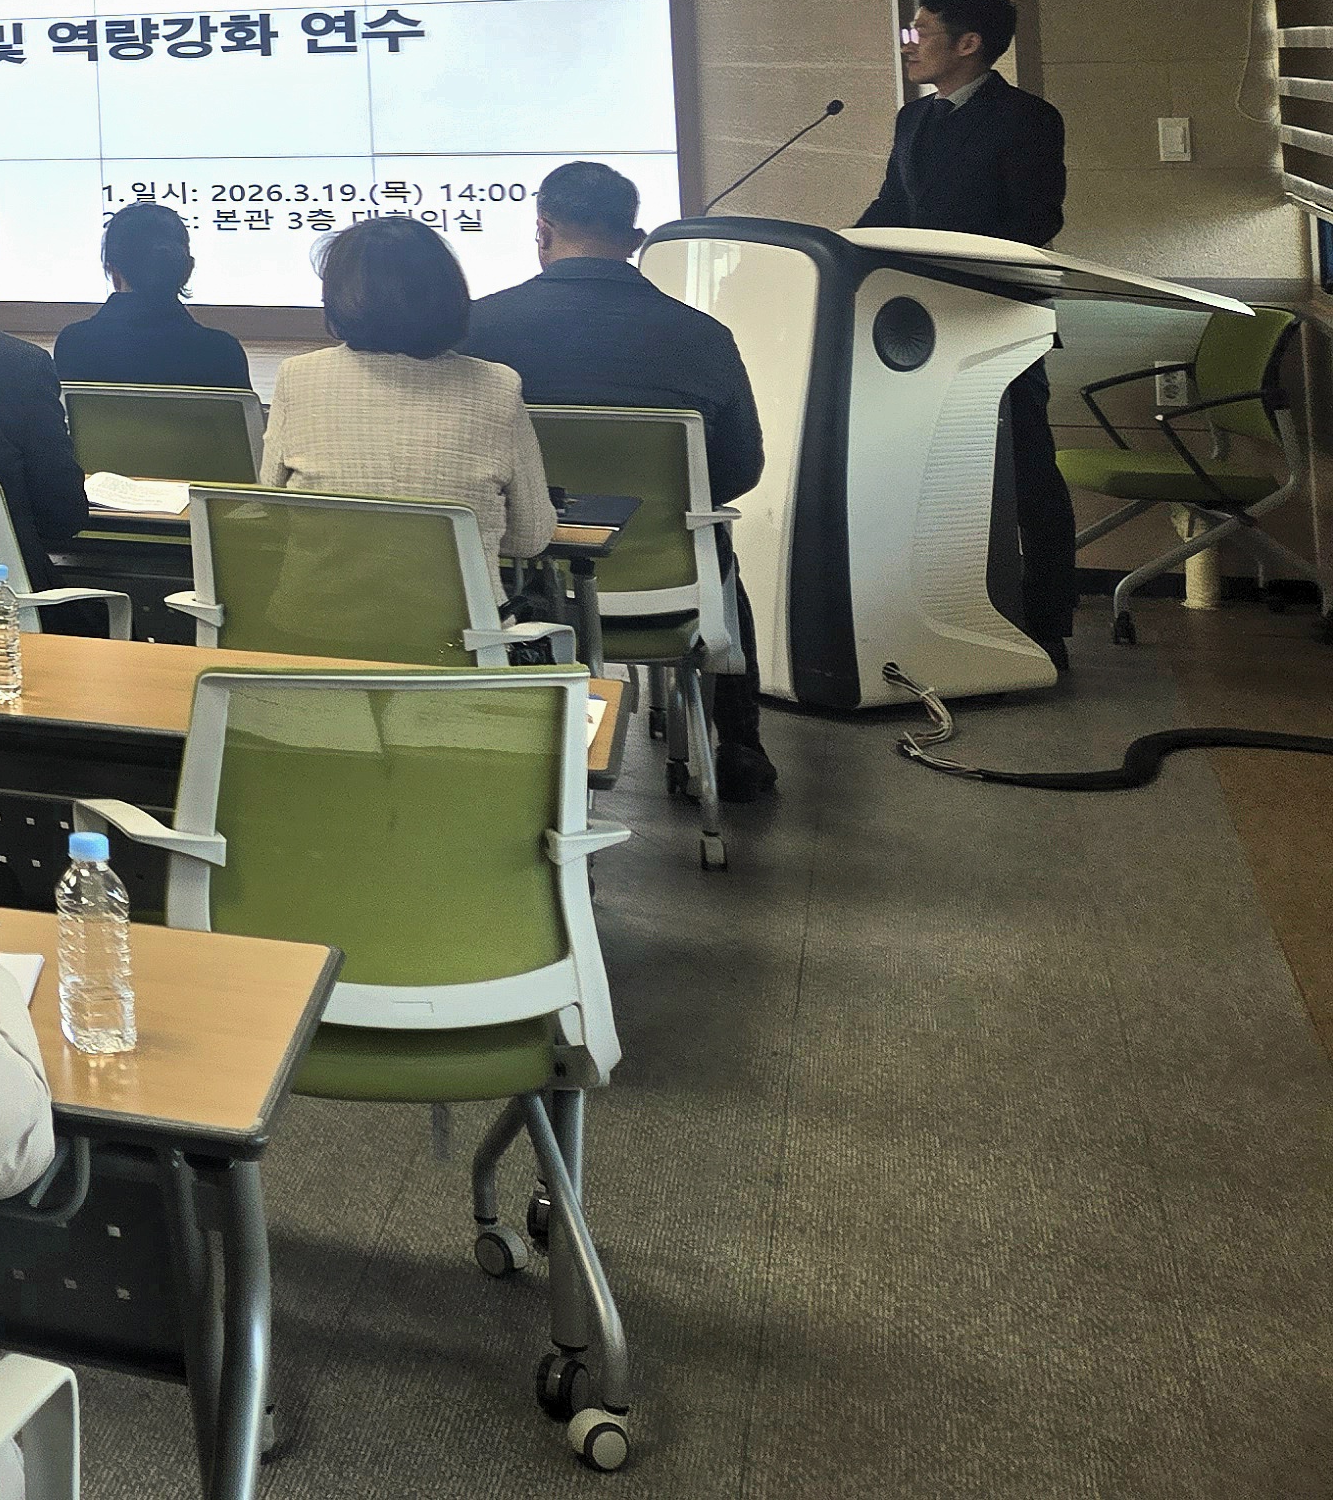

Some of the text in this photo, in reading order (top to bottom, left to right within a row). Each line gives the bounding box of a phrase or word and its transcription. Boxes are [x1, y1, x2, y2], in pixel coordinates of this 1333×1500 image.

[47, 12, 279, 61] 역량강화
[300, 9, 426, 54] 연수
[211, 181, 423, 205] 2026.3.19.(목)
[440, 183, 539, 202] 14:00
[212, 209, 274, 231] 본관
[288, 209, 336, 231] 3층
